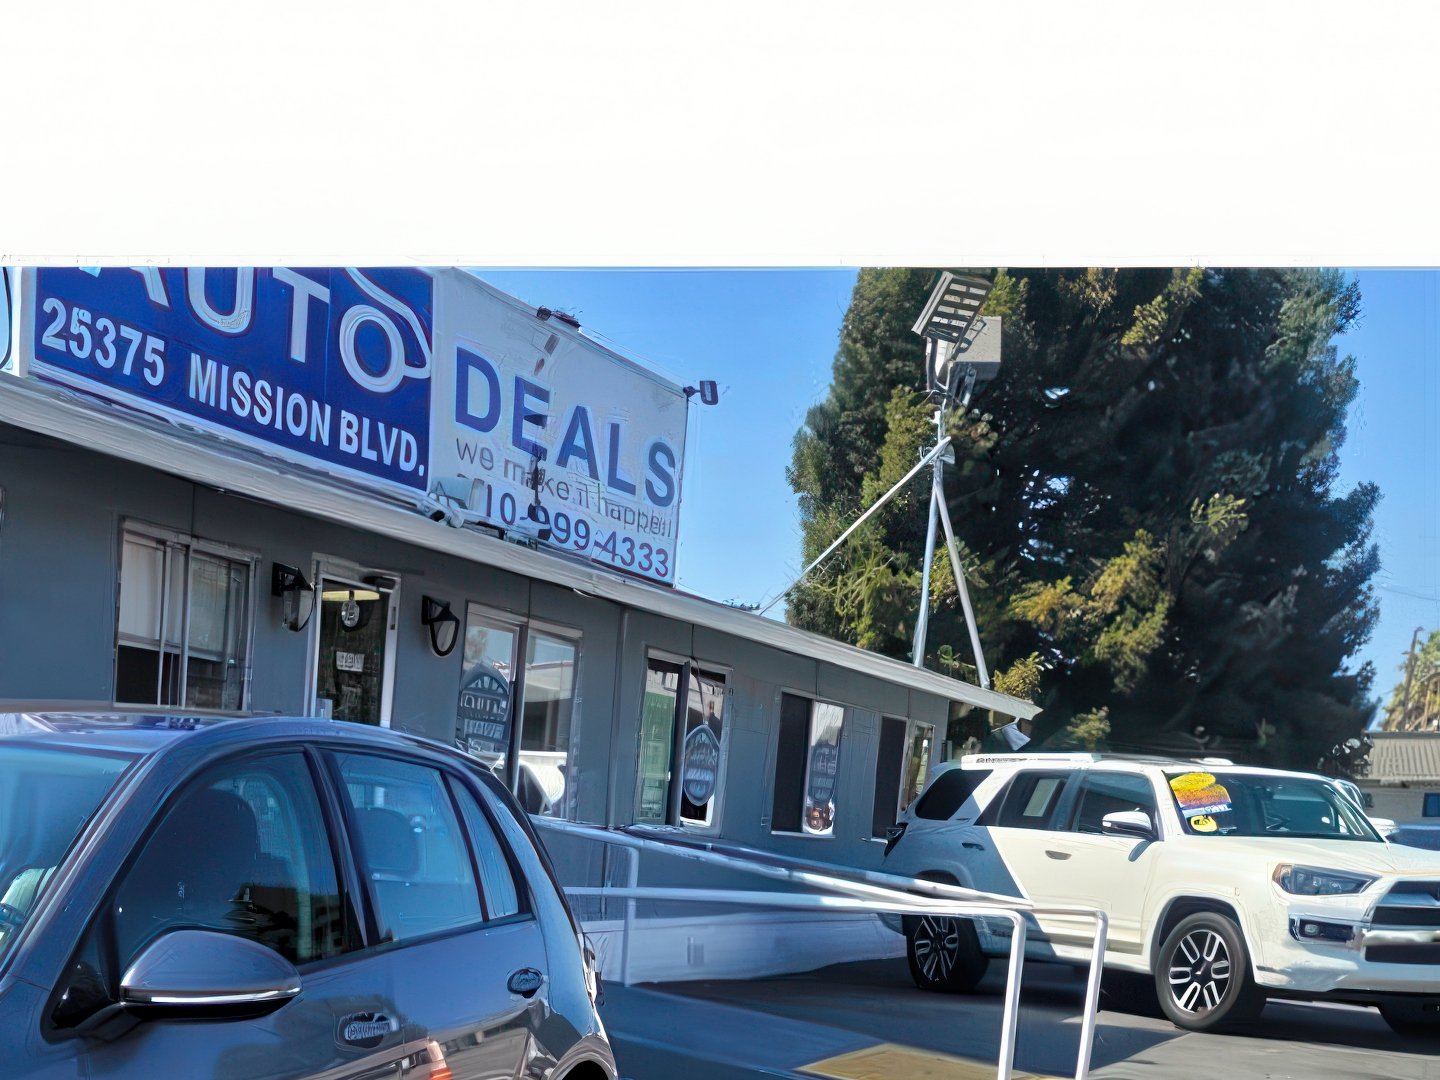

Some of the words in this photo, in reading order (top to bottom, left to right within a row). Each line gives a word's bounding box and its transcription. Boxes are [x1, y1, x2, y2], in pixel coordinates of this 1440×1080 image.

[41, 297, 165, 387] 25375
[188, 351, 331, 447] MISSION
[339, 409, 425, 477] BLVD.
[455, 346, 676, 507] DEALS
